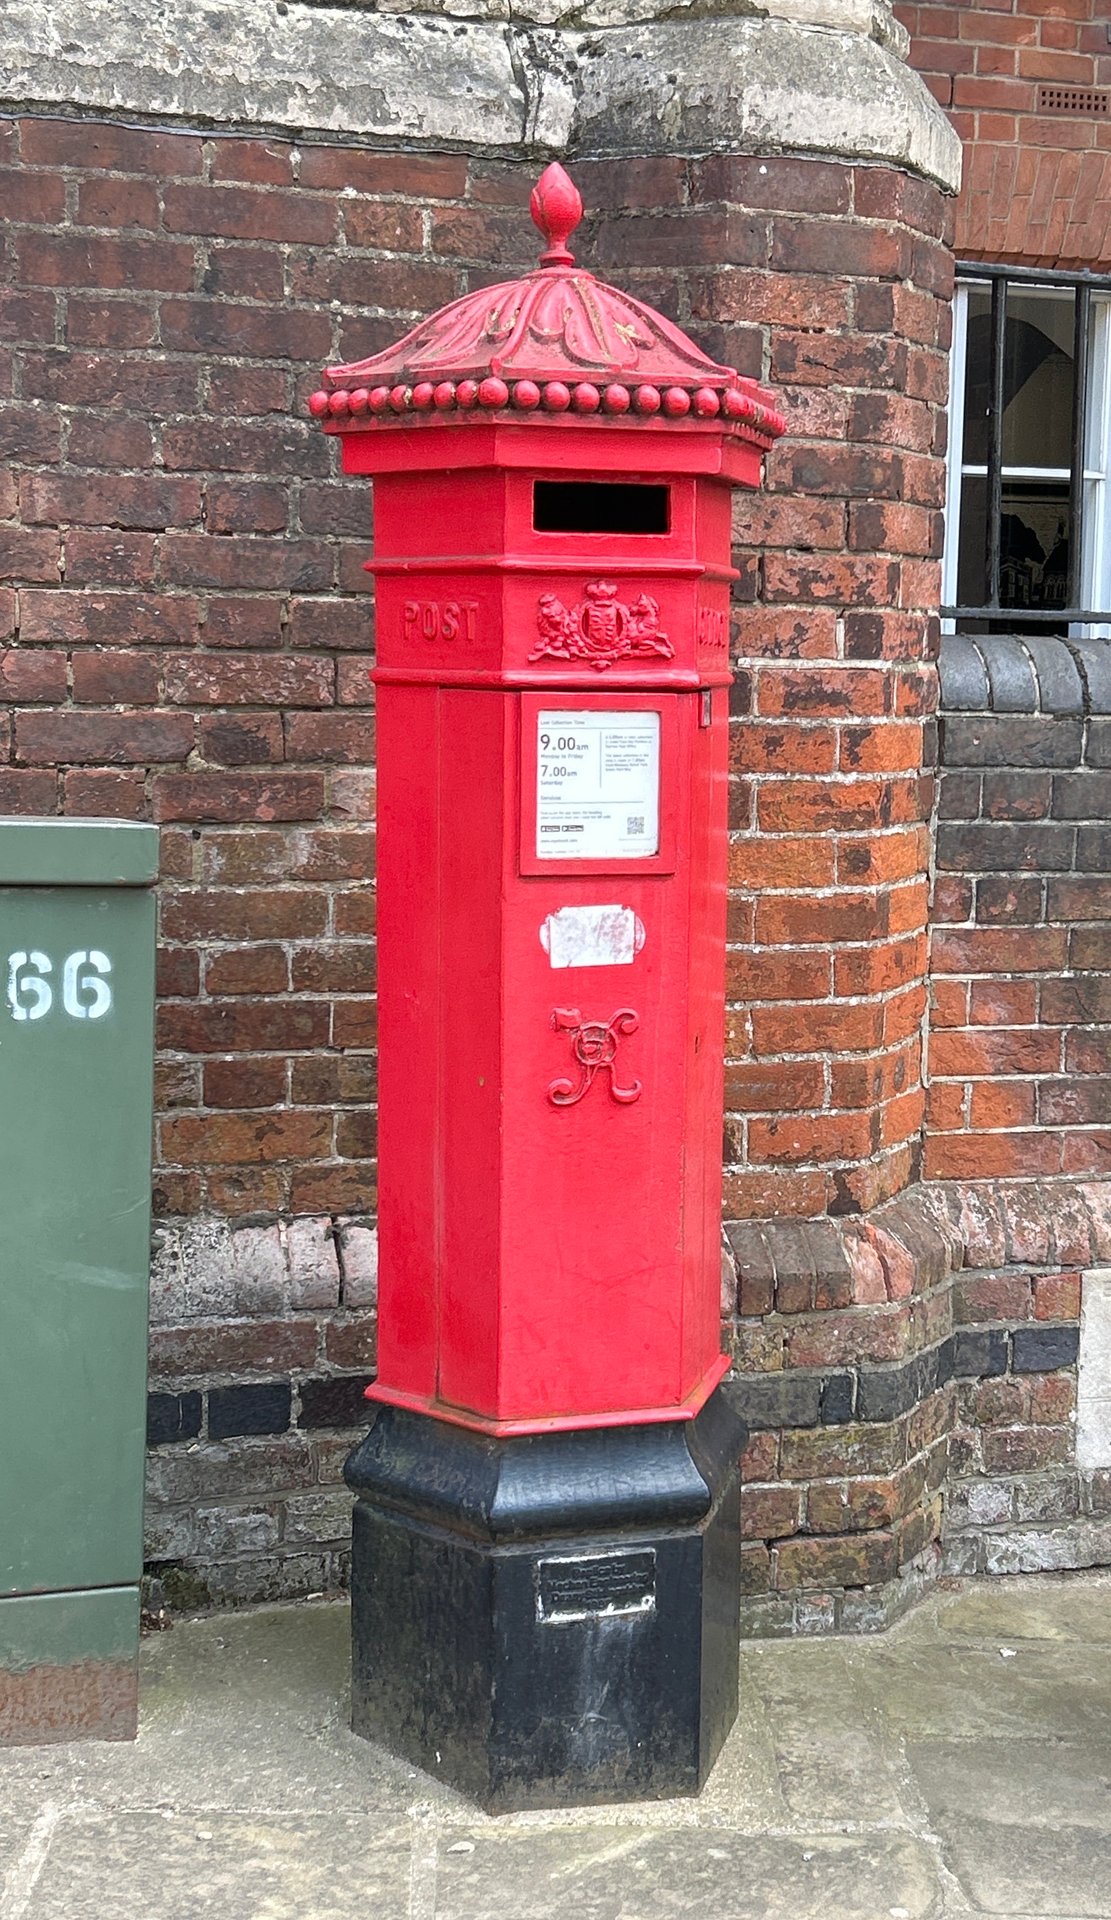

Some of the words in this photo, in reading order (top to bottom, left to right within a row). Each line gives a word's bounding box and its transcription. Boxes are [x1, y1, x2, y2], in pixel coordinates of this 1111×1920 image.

[403, 600, 479, 642] POST
[540, 733, 589, 751] 9.00am
[540, 764, 578, 777] 7.00am
[7, 950, 112, 1020] 66
